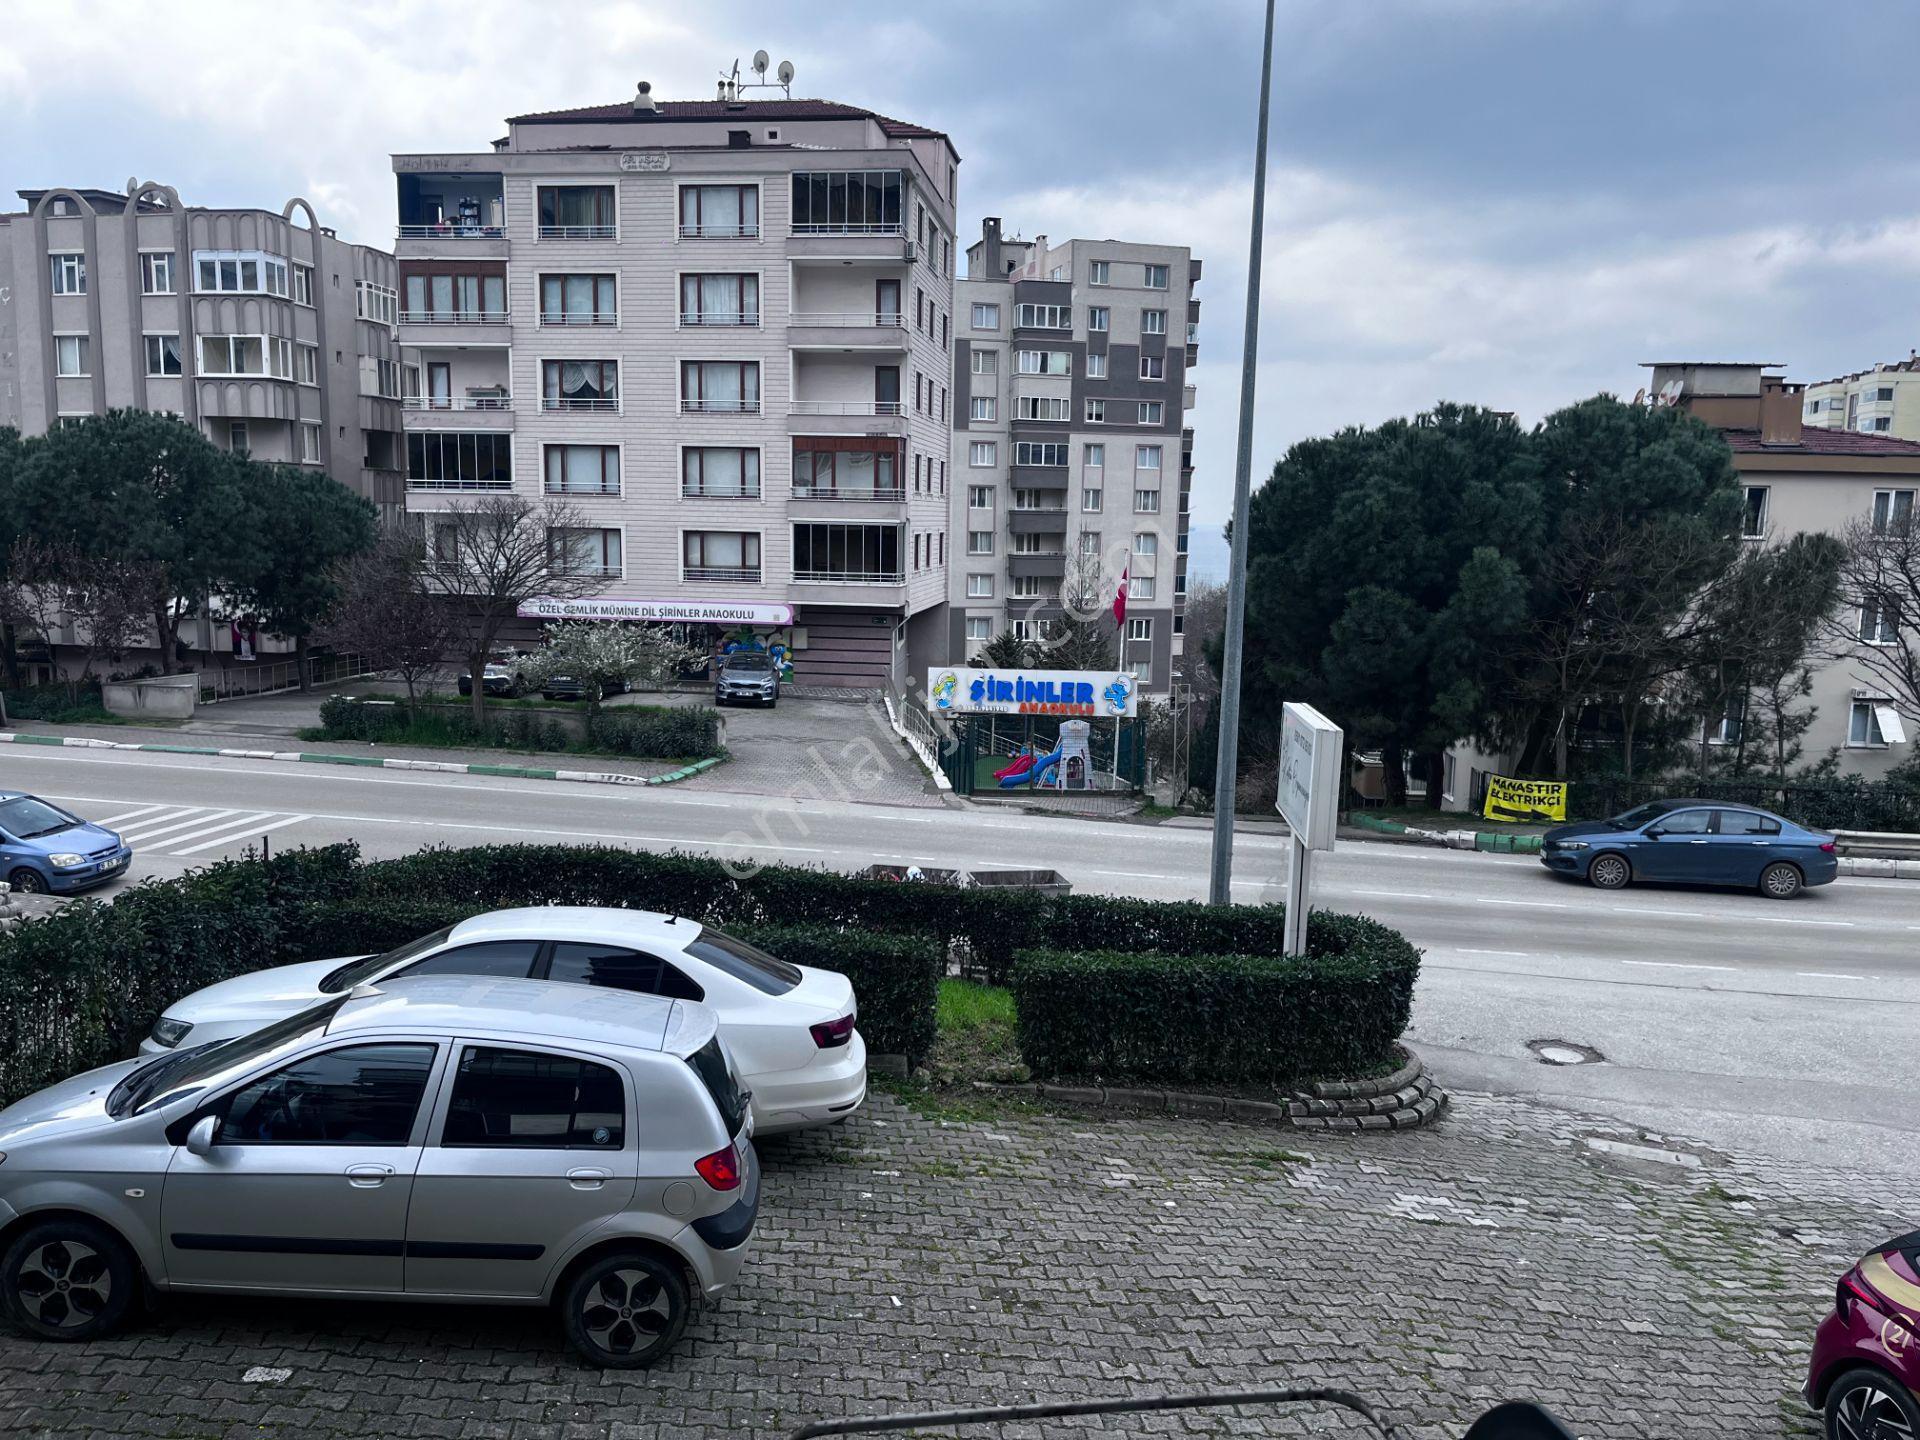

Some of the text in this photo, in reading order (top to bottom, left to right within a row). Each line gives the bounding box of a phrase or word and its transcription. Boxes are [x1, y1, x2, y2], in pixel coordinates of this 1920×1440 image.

[539, 602, 561, 614] ÖZEL
[600, 604, 640, 617] MÜMİNE
[641, 606, 657, 617] DİL
[658, 606, 700, 619] ŞİRİNLER
[701, 608, 754, 620] ANAOKULU
[970, 675, 1095, 706] ŞİRİNLER
[1019, 702, 1095, 716] ANAOKULU
[1492, 777, 1562, 795] MANASTIR
[1490, 788, 1561, 808] ELEKTRİKÇİ
